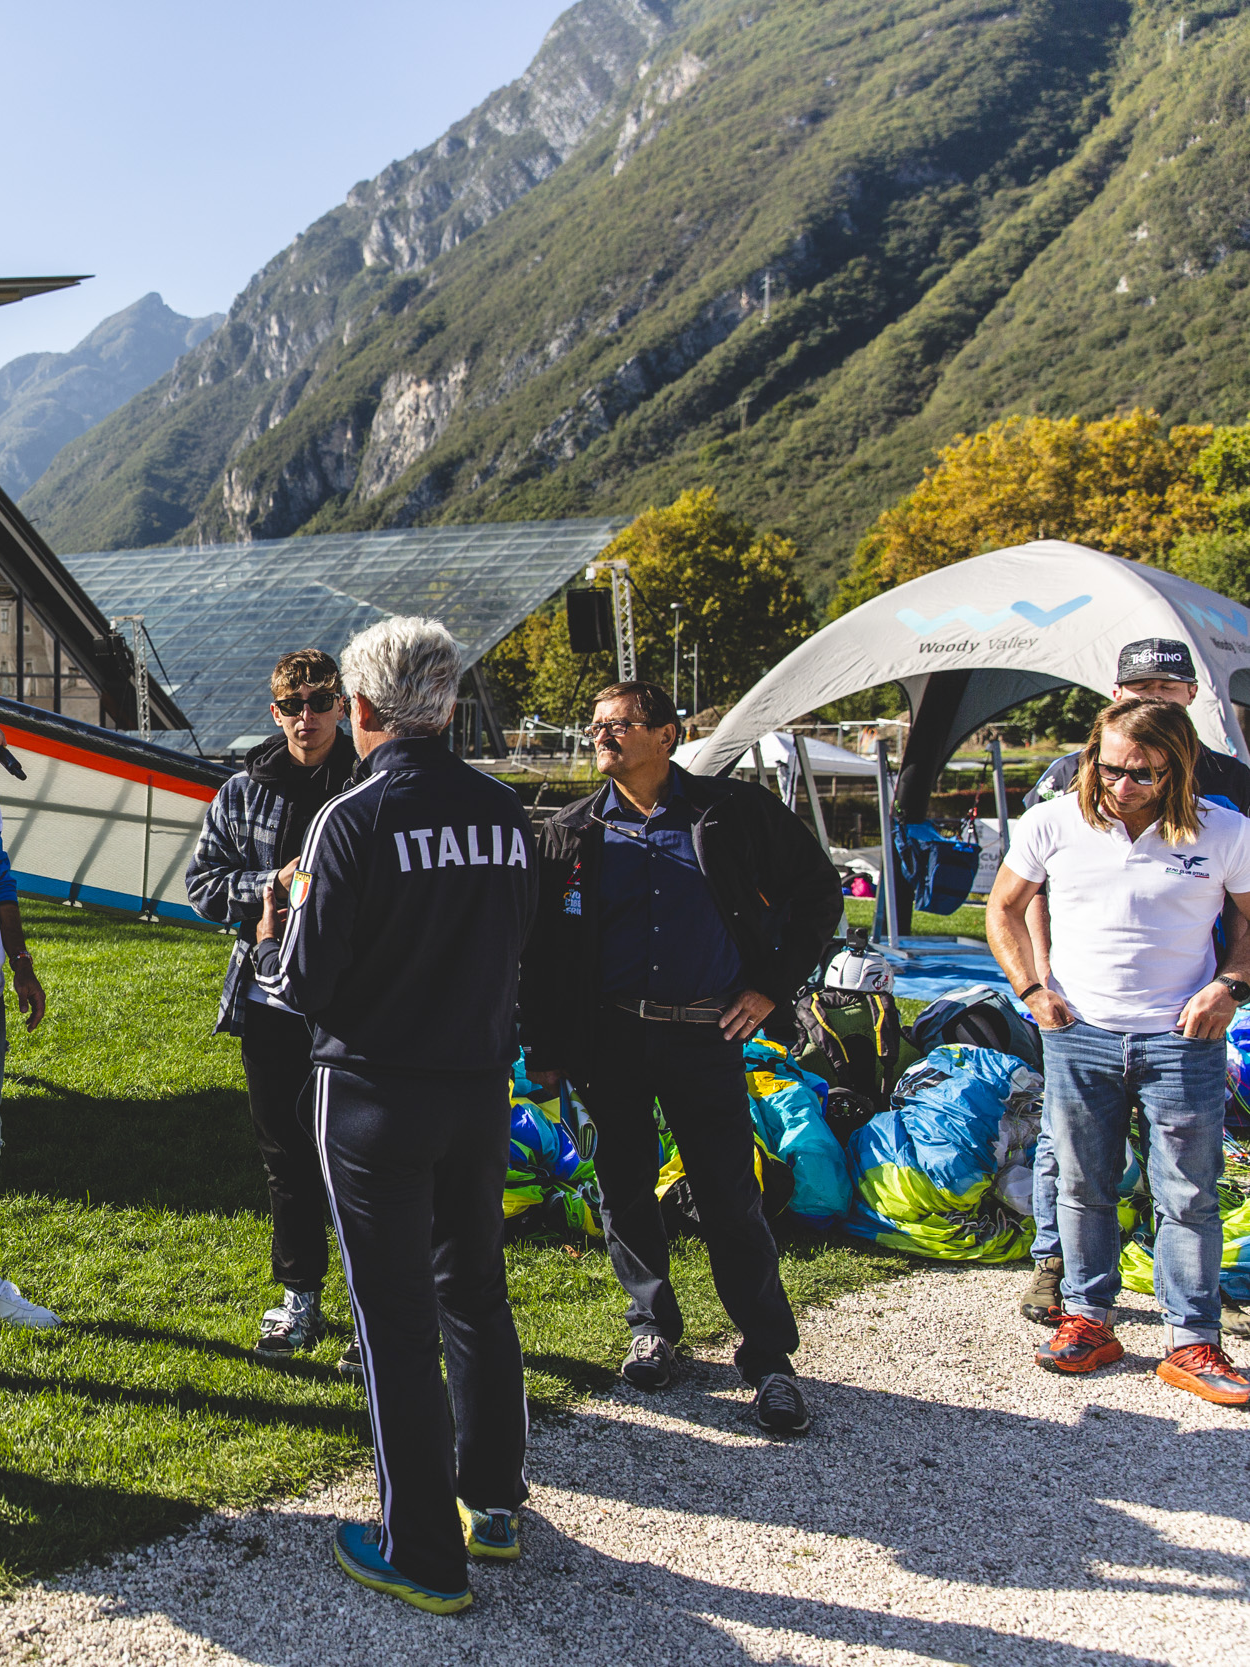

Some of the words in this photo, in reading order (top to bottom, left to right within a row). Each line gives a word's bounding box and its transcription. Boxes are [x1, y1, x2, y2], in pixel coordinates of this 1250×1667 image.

[918, 639, 980, 654] Woody
[988, 637, 1039, 651] Valley
[1131, 649, 1182, 664] TRENTINO
[393, 825, 527, 872] ITALIA
